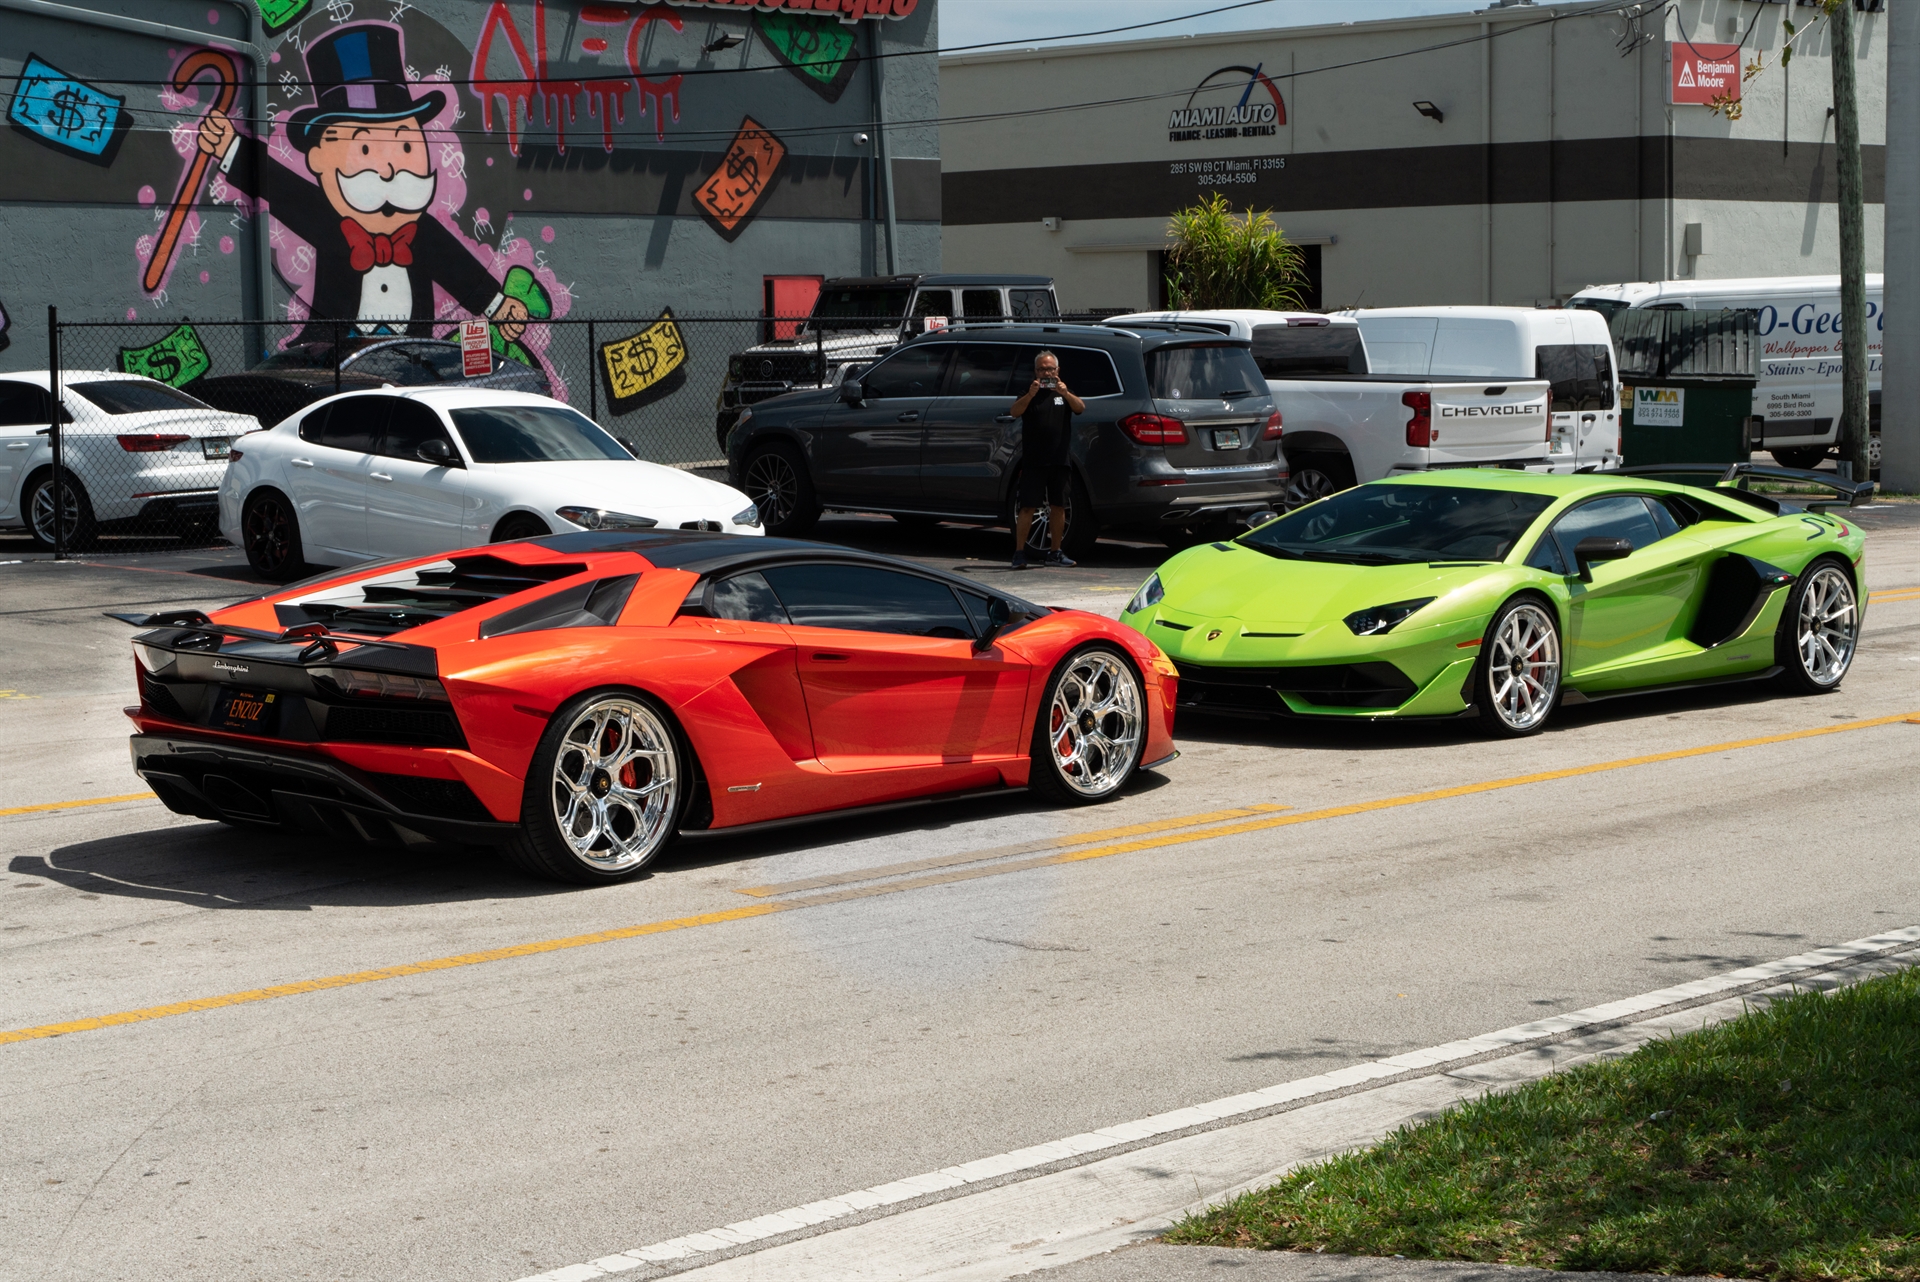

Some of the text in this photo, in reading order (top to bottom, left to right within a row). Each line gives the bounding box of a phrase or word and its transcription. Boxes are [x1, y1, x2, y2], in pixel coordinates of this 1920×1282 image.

[470, 0, 684, 140] ALEC
[1697, 60, 1735, 76] Benjamin
[1697, 74, 1724, 88] Moore
[1168, 103, 1276, 128] MIAMI AUTO
[1169, 125, 1276, 142] FINANCE LEASING RENTALS
[1170, 163, 1187, 174] 2851
[1188, 161, 1203, 173] SW
[1203, 161, 1213, 172] 69
[1213, 160, 1225, 171] CT
[1226, 160, 1253, 172] Miami,
[1262, 158, 1285, 169] 33155
[1197, 172, 1257, 185] 305-264-5506
[1763, 341, 1829, 358] Wallpaper
[1639, 390, 1679, 402] WM
[1791, 392, 1811, 400] Miami
[1442, 404, 1543, 417] CHEVROLET
[1769, 409, 1812, 418] 305-666-3300
[212, 660, 249, 673] Lamborghini
